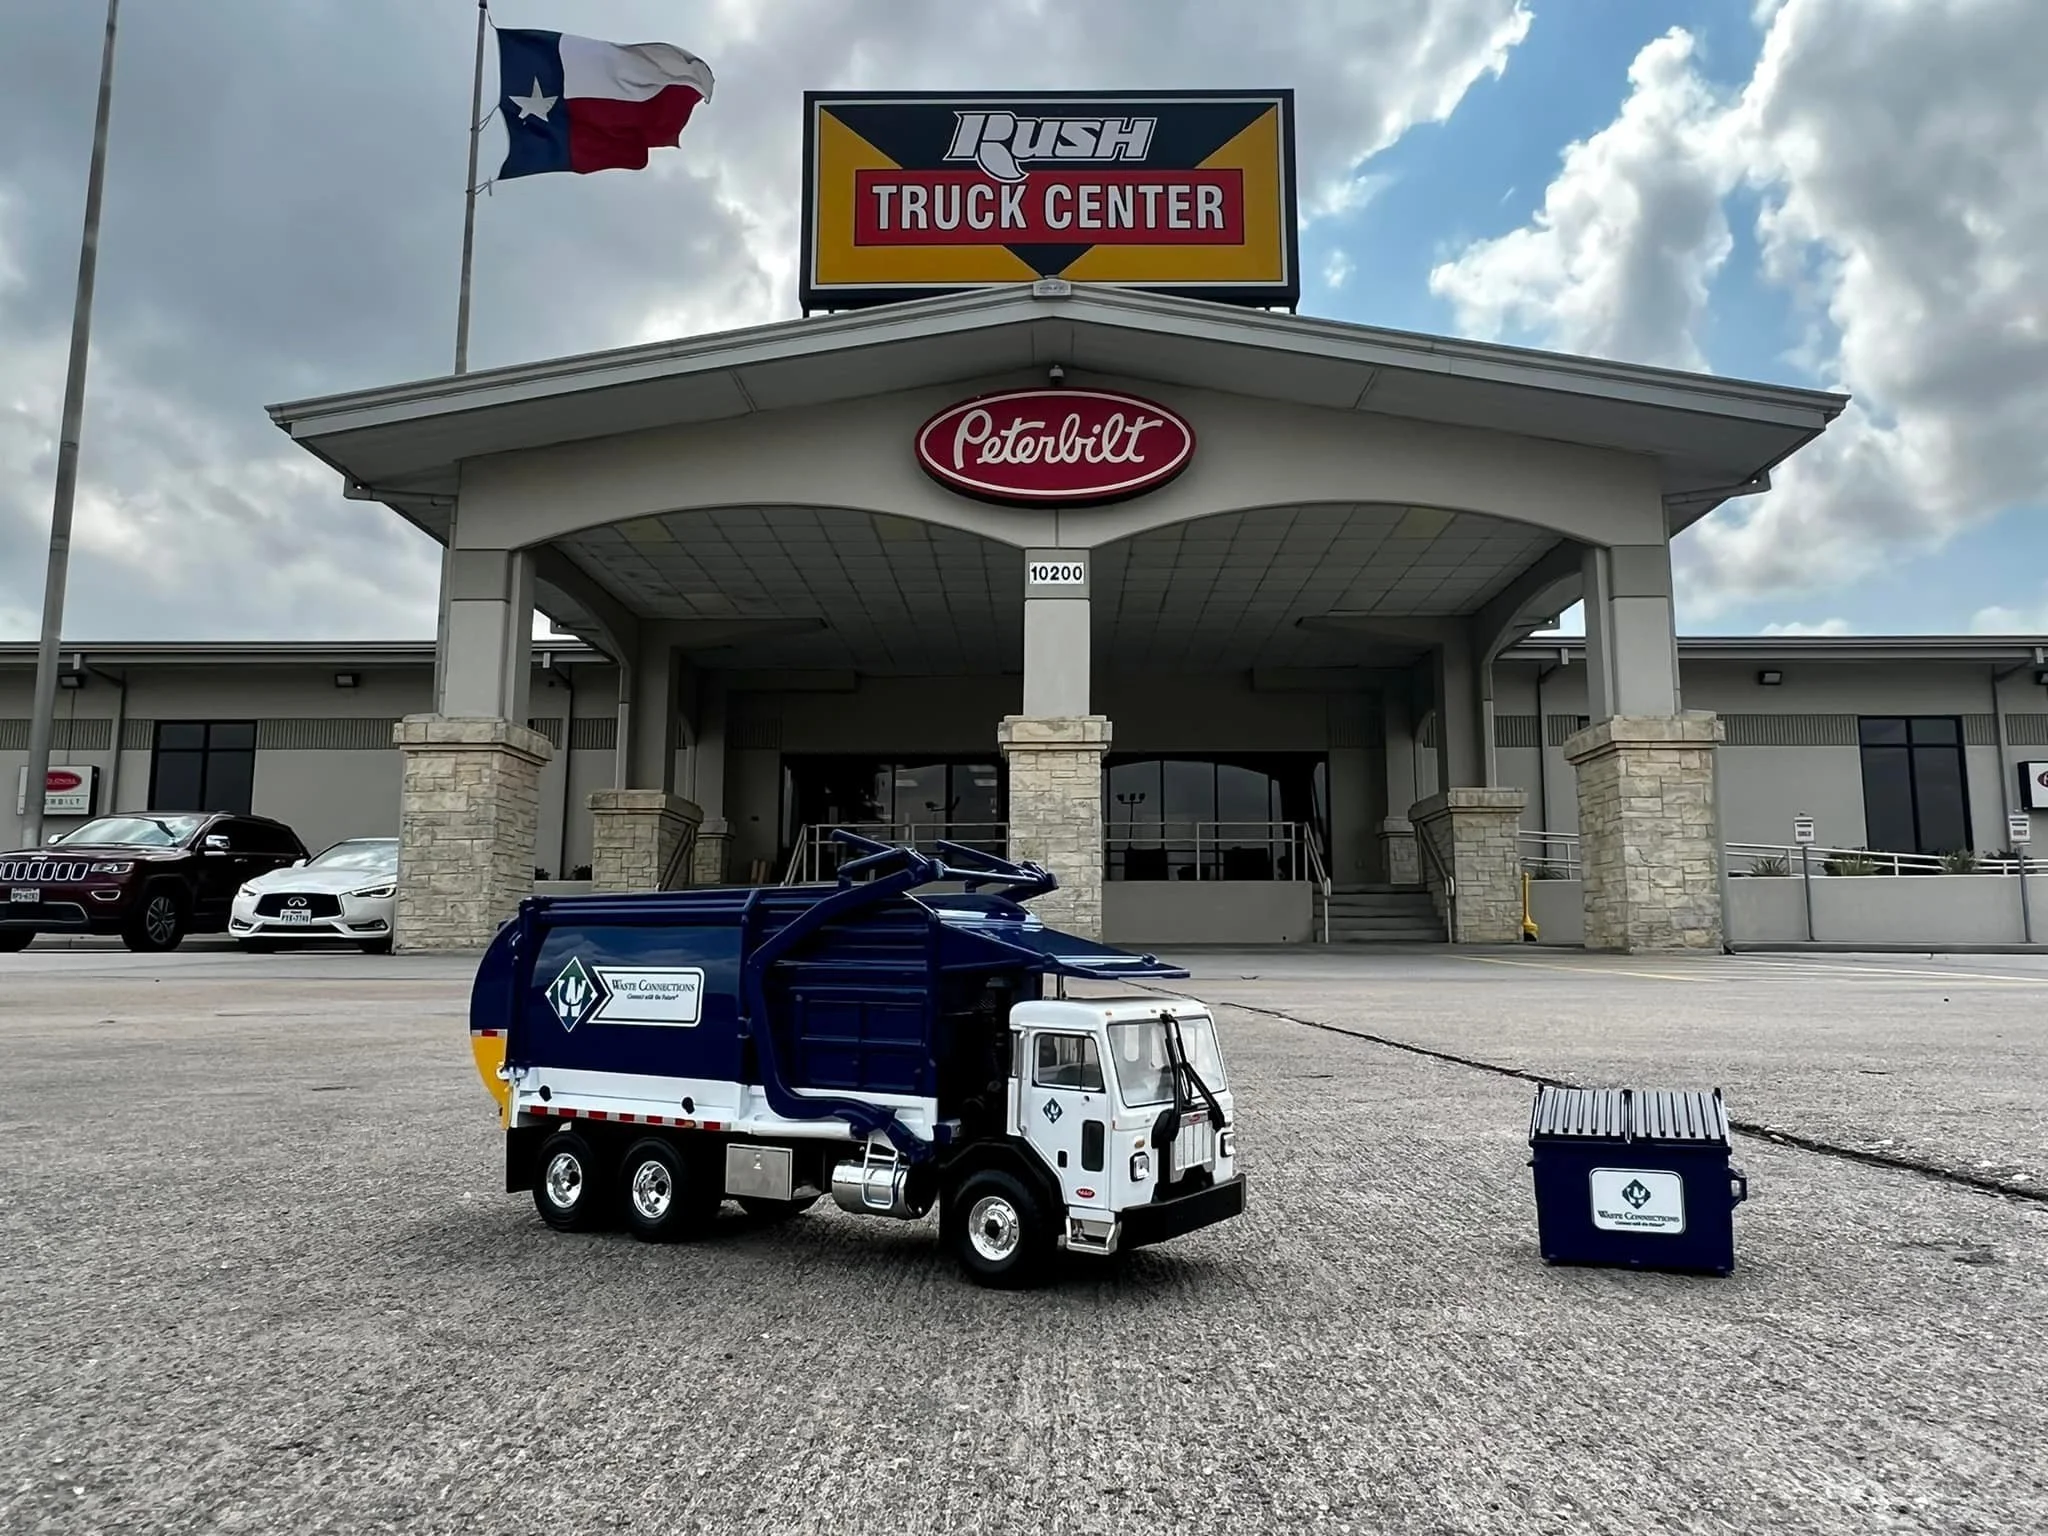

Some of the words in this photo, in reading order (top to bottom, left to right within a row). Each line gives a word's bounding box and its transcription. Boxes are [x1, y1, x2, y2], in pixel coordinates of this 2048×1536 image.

[871, 184, 1027, 230] TRUCK
[1044, 184, 1225, 230] CENTER
[953, 409, 1163, 470] Peterbilt
[1030, 566, 1083, 581] 10200
